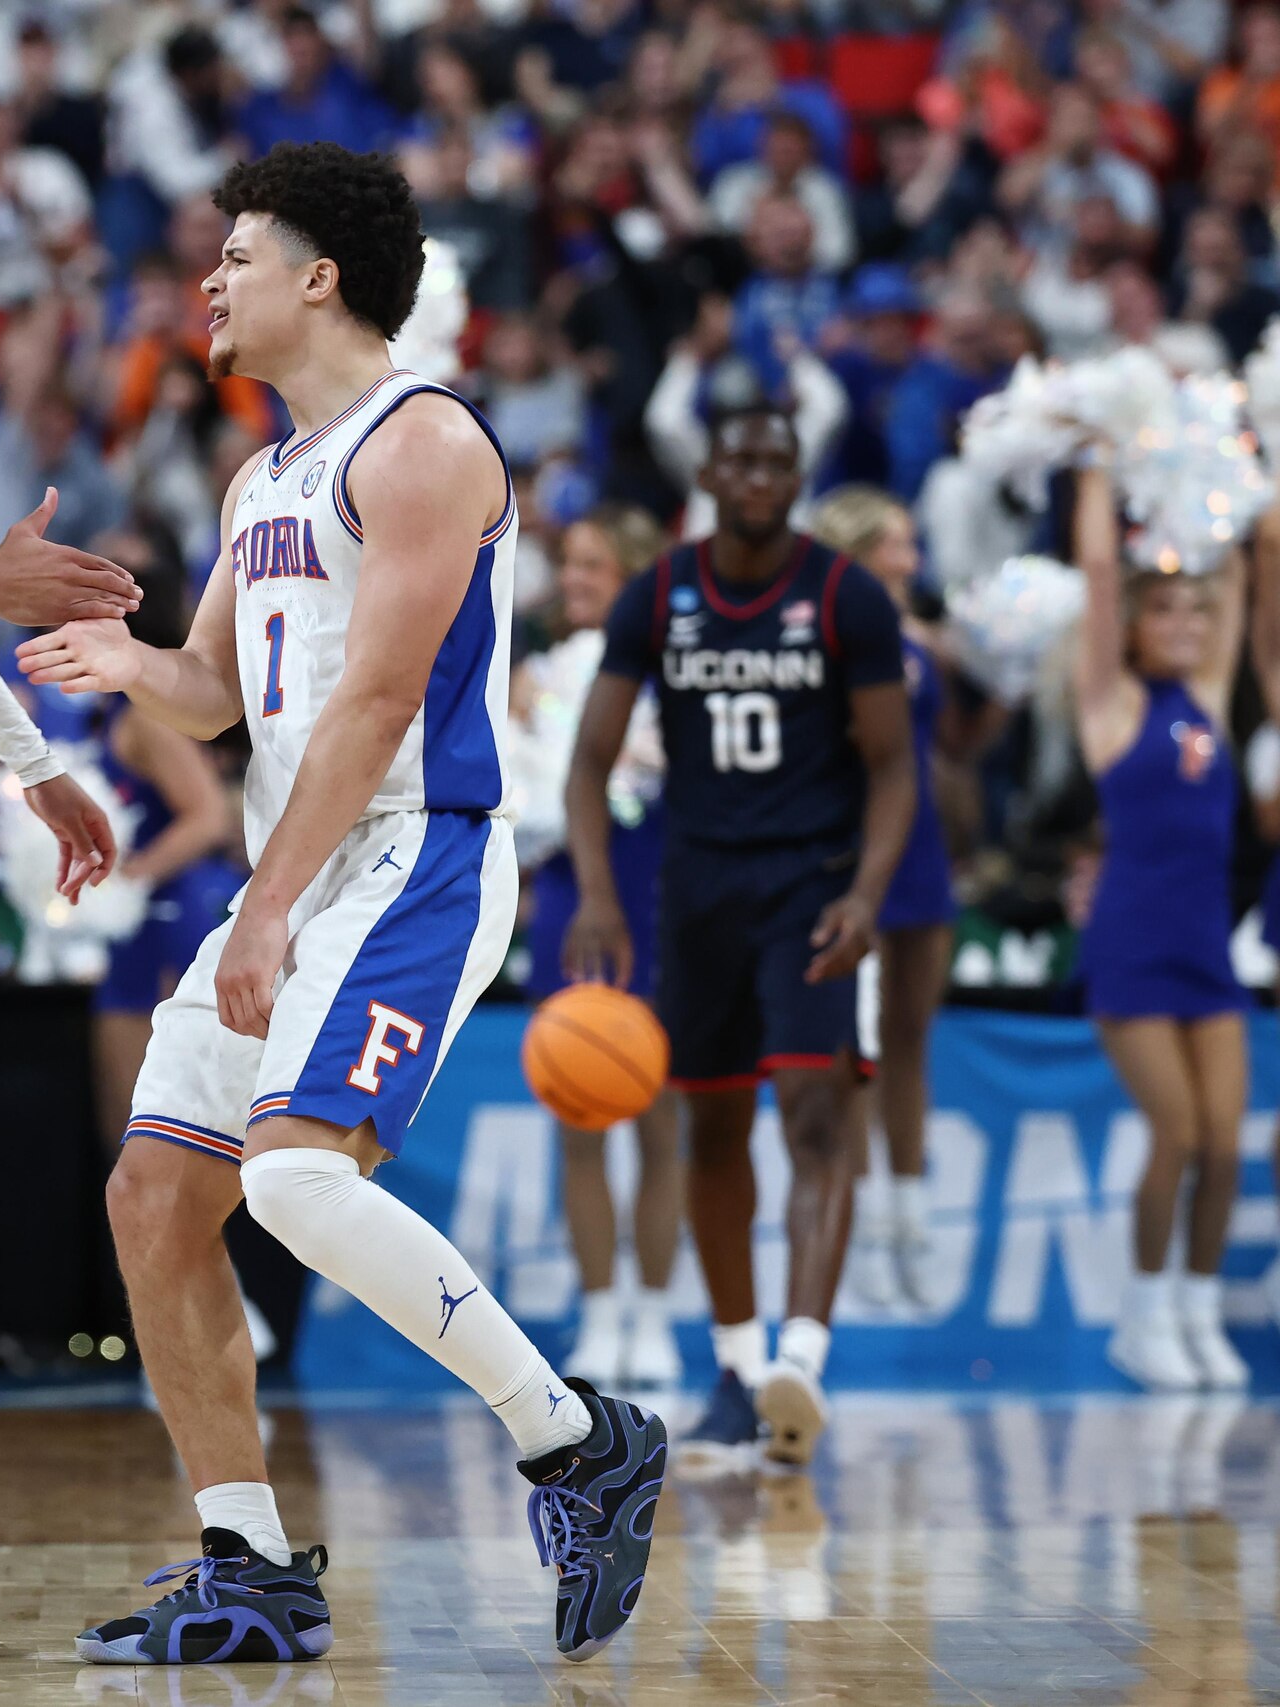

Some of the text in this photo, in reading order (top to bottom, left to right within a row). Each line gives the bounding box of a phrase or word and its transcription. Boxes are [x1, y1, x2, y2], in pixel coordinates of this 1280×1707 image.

[231, 516, 330, 592] FLORDA
[262, 612, 285, 718] 1
[663, 649, 824, 691] UCONN
[704, 691, 782, 774] 10
[345, 999, 427, 1098] F
